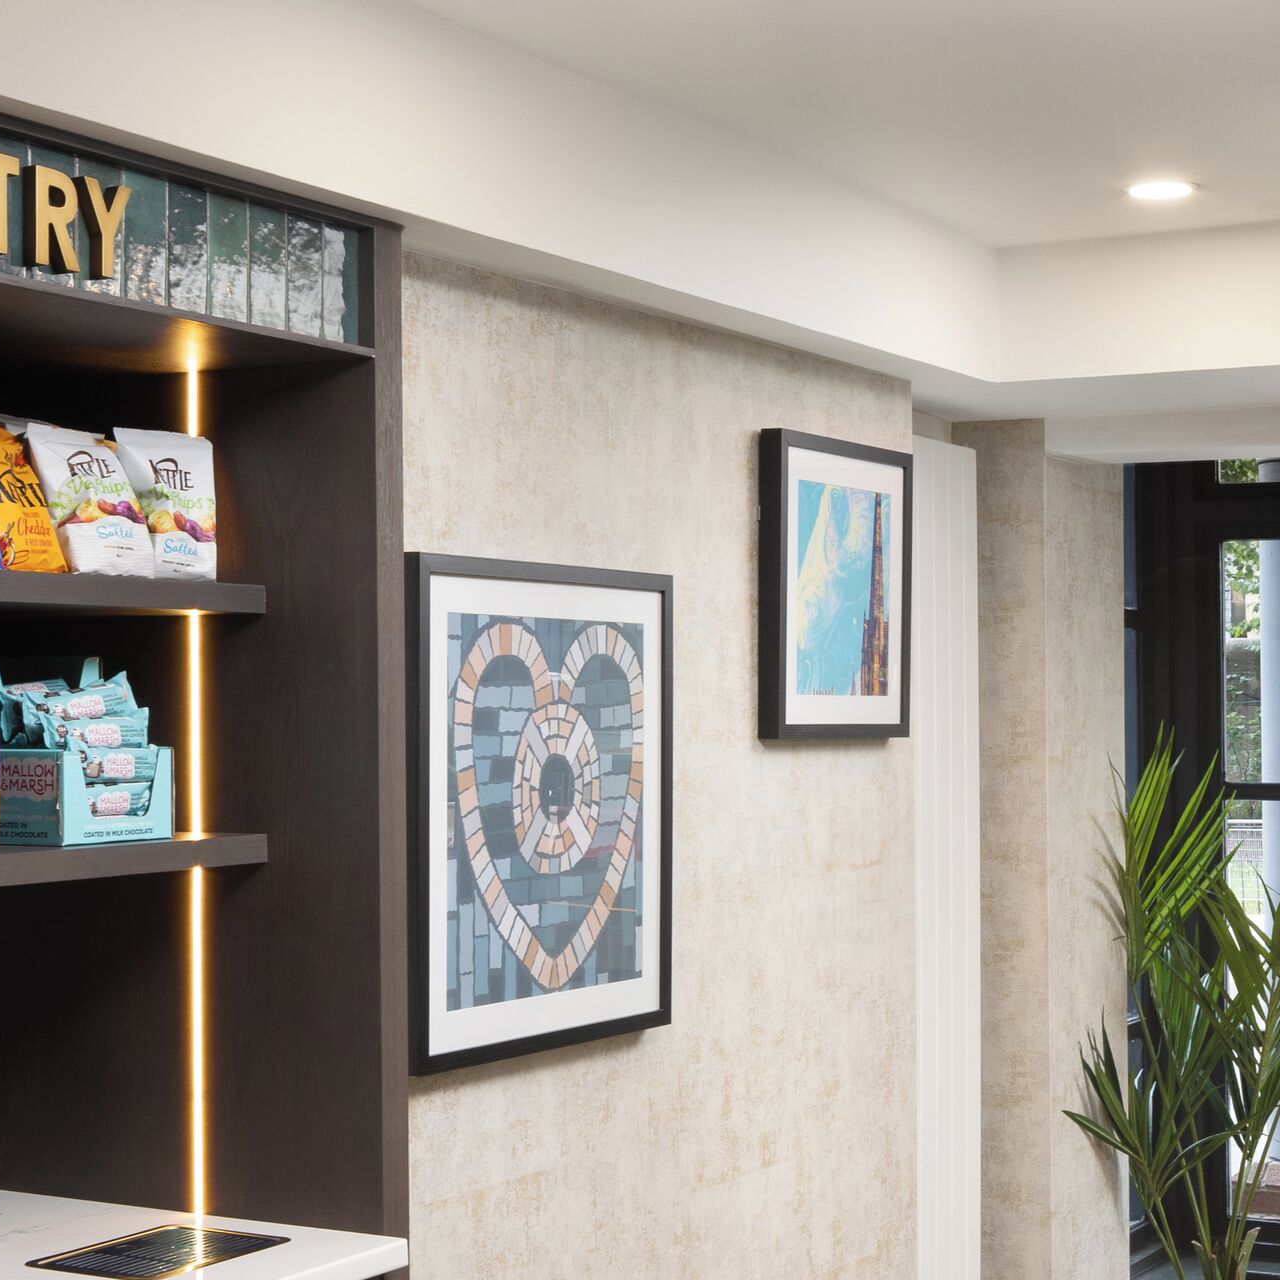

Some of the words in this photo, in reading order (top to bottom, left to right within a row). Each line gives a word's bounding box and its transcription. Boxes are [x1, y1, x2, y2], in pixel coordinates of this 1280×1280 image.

[163, 538, 199, 557] Salted
[70, 698, 103, 710] MALLOW
[1, 763, 56, 778] MALLOW
[0, 777, 56, 796] &MARSH
[83, 831, 104, 839] COATED
[124, 828, 154, 836] CHOCOLATE
